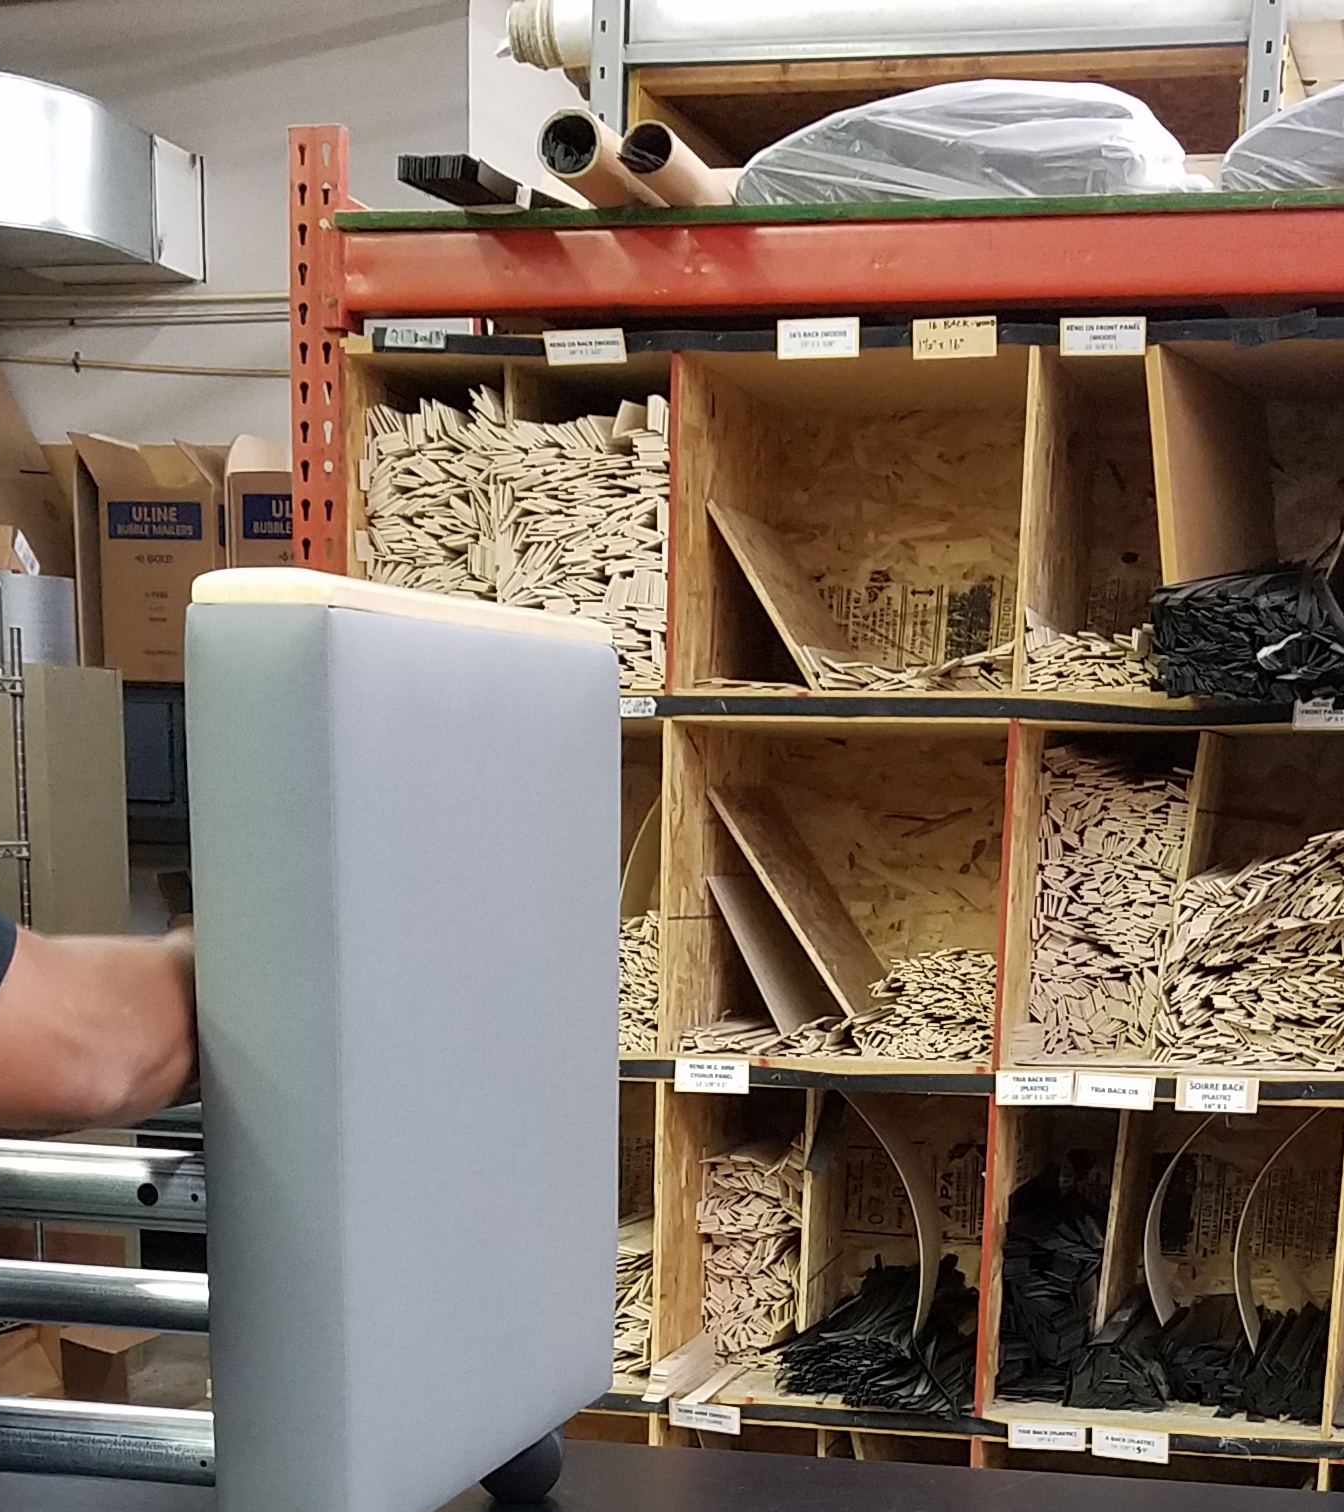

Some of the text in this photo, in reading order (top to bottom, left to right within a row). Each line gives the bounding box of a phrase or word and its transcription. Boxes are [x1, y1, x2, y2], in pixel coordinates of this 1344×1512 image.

[132, 506, 178, 522] ULINE
[117, 523, 150, 536] BUBBLE
[1222, 1083, 1244, 1092] BACK
[939, 1172, 954, 1220] APA
